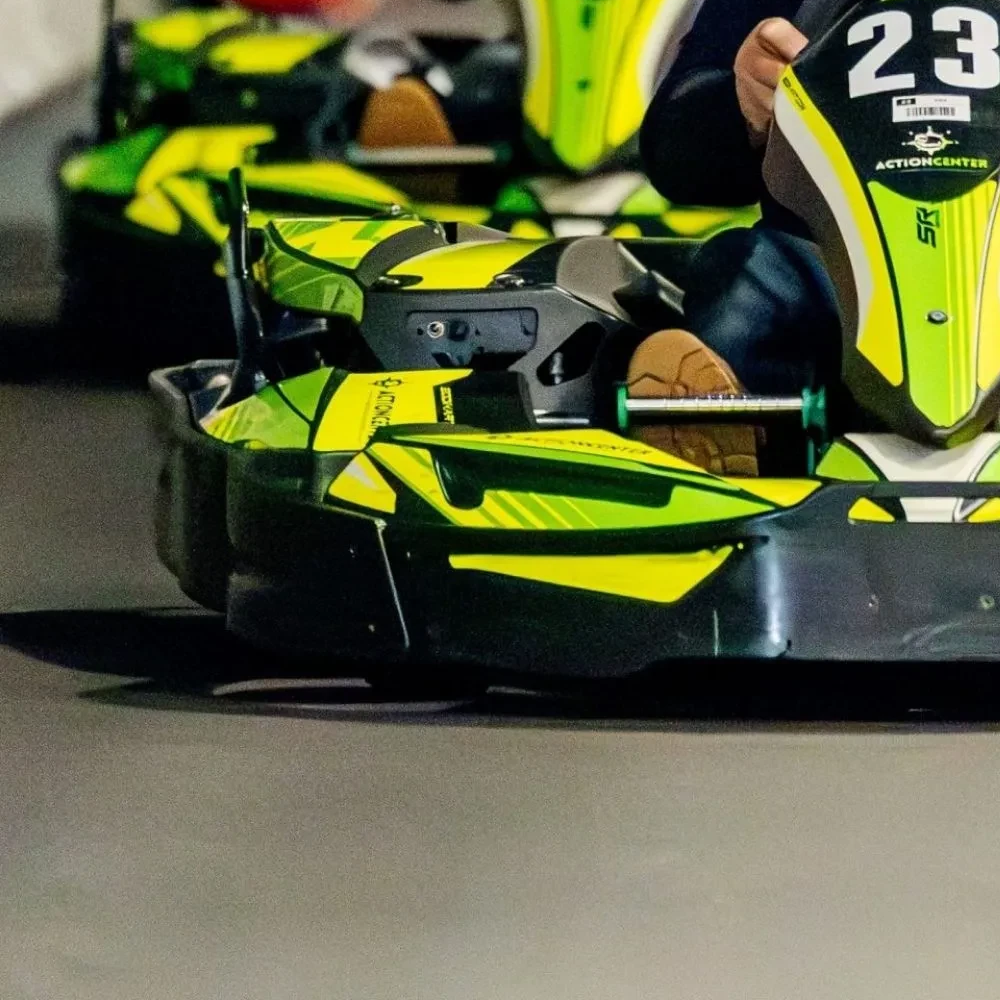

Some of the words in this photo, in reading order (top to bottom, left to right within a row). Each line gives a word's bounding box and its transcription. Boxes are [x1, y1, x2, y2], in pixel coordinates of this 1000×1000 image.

[847, 6, 1000, 98] 23
[876, 156, 988, 171] ACTIONCENTER
[915, 207, 940, 248] SR
